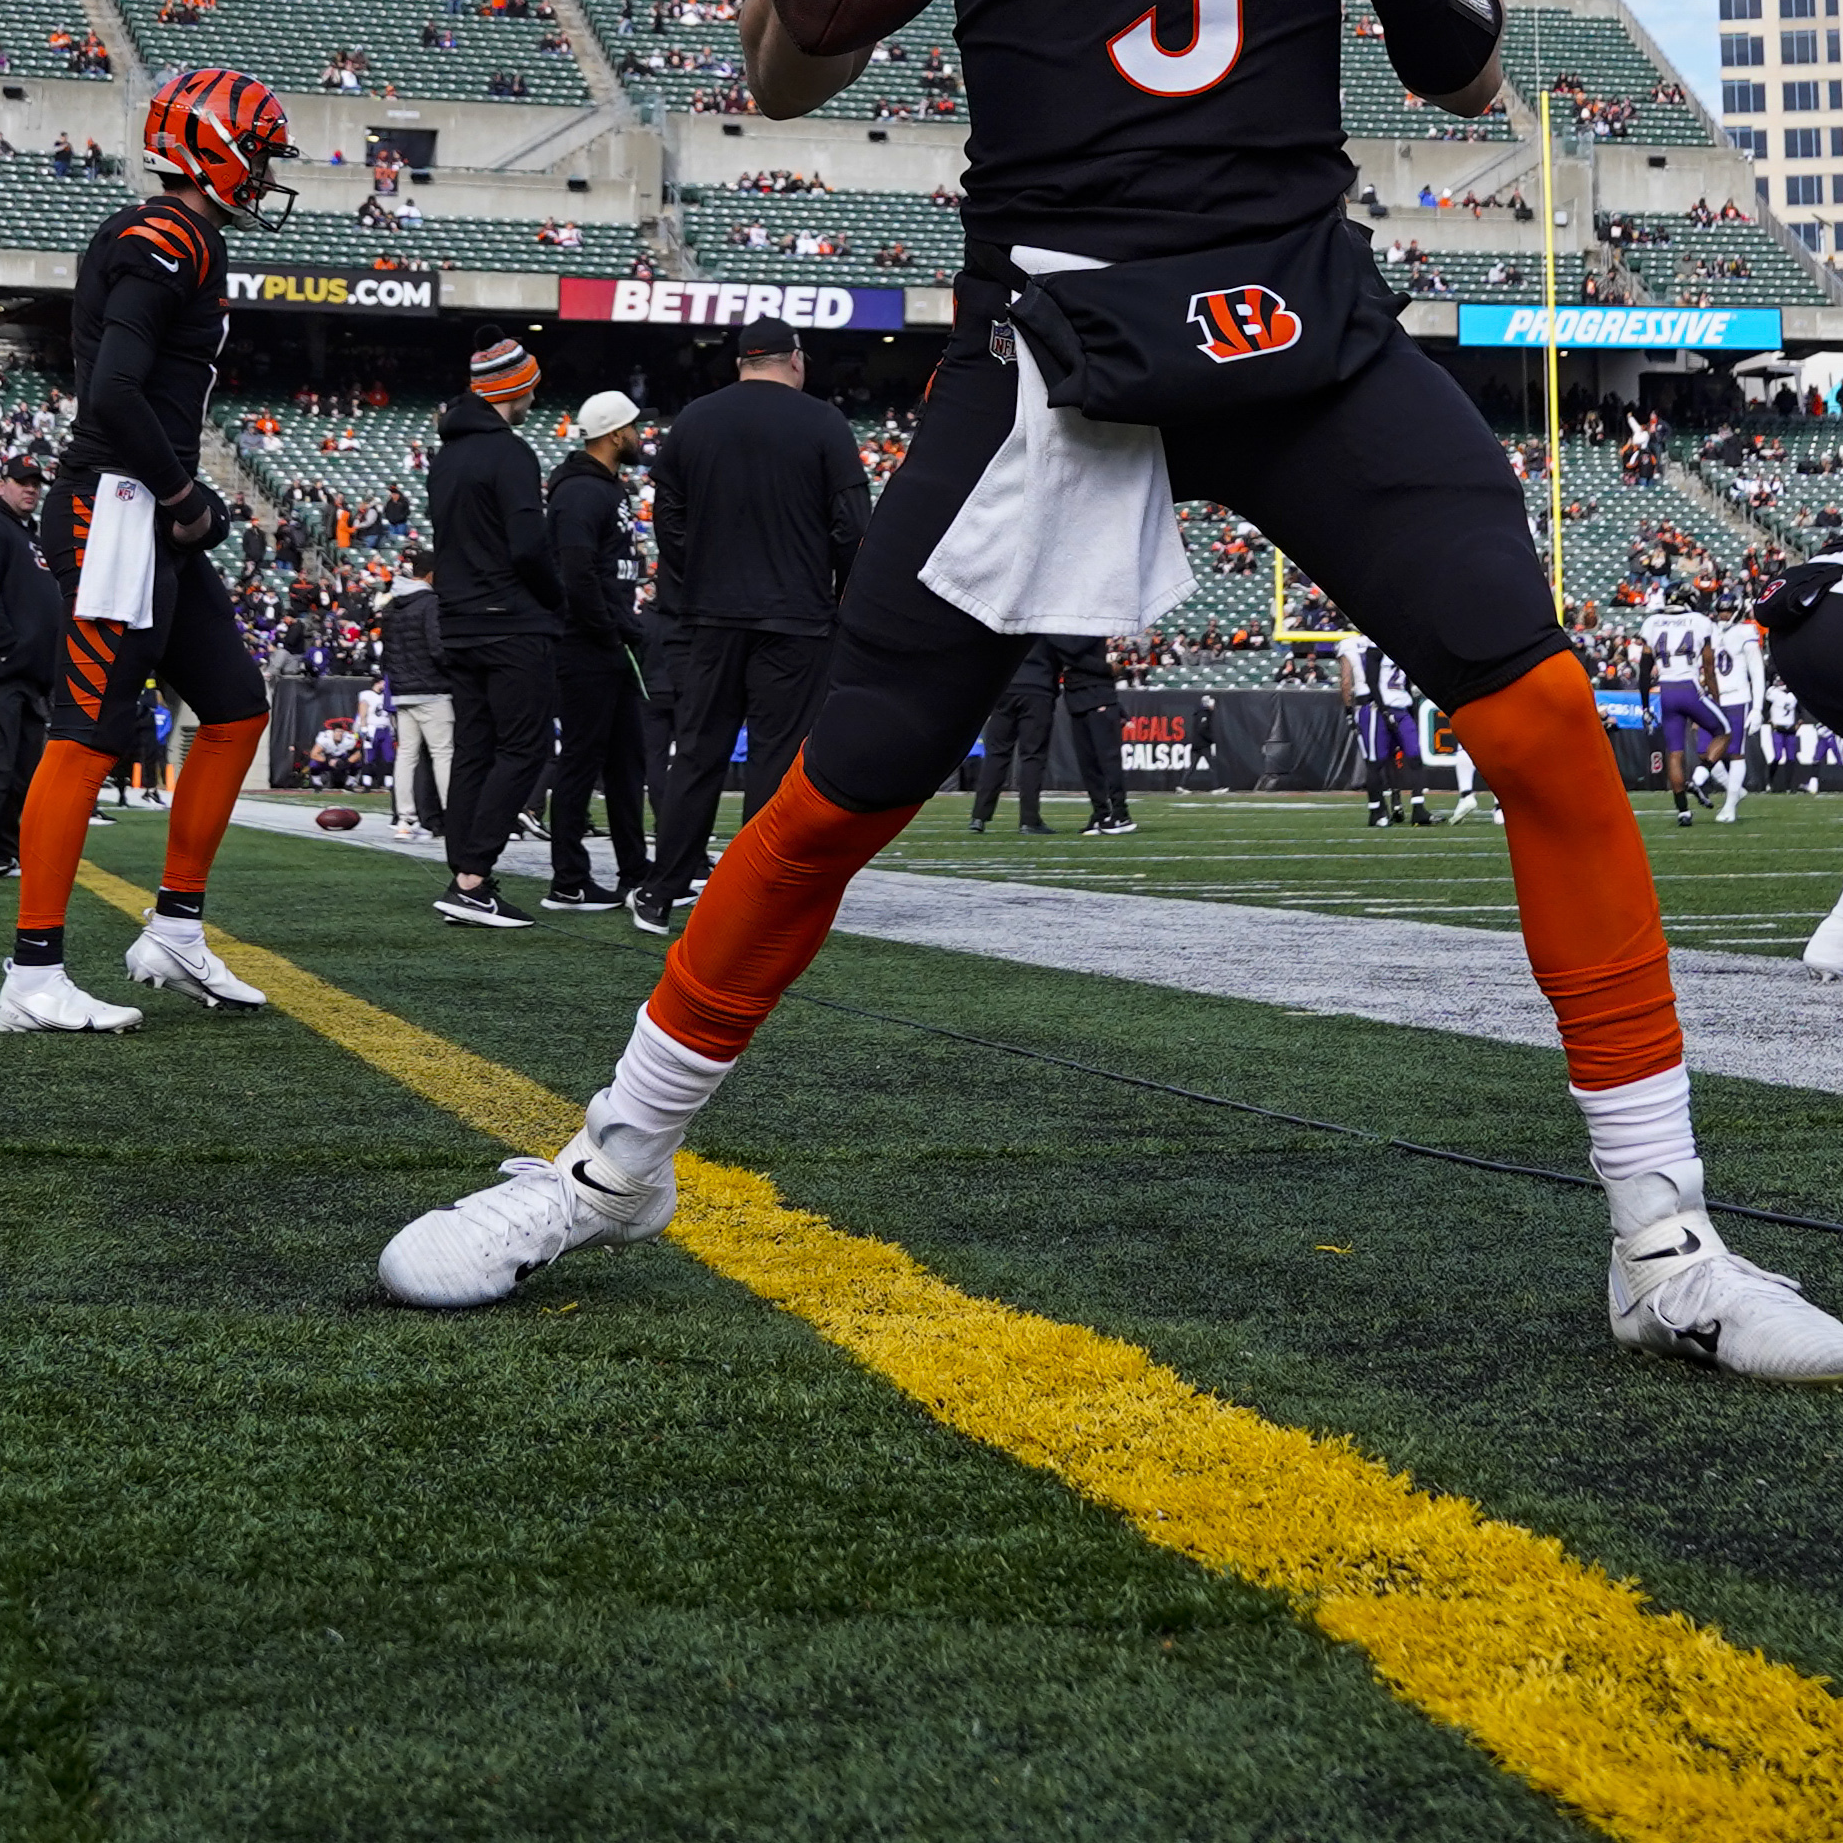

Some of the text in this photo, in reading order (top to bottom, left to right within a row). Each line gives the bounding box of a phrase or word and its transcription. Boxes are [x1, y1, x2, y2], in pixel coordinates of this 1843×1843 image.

[611, 279, 854, 329] BETFRED
[1504, 309, 1732, 345] PROGRESSIVE
[1654, 630, 1696, 667] 44
